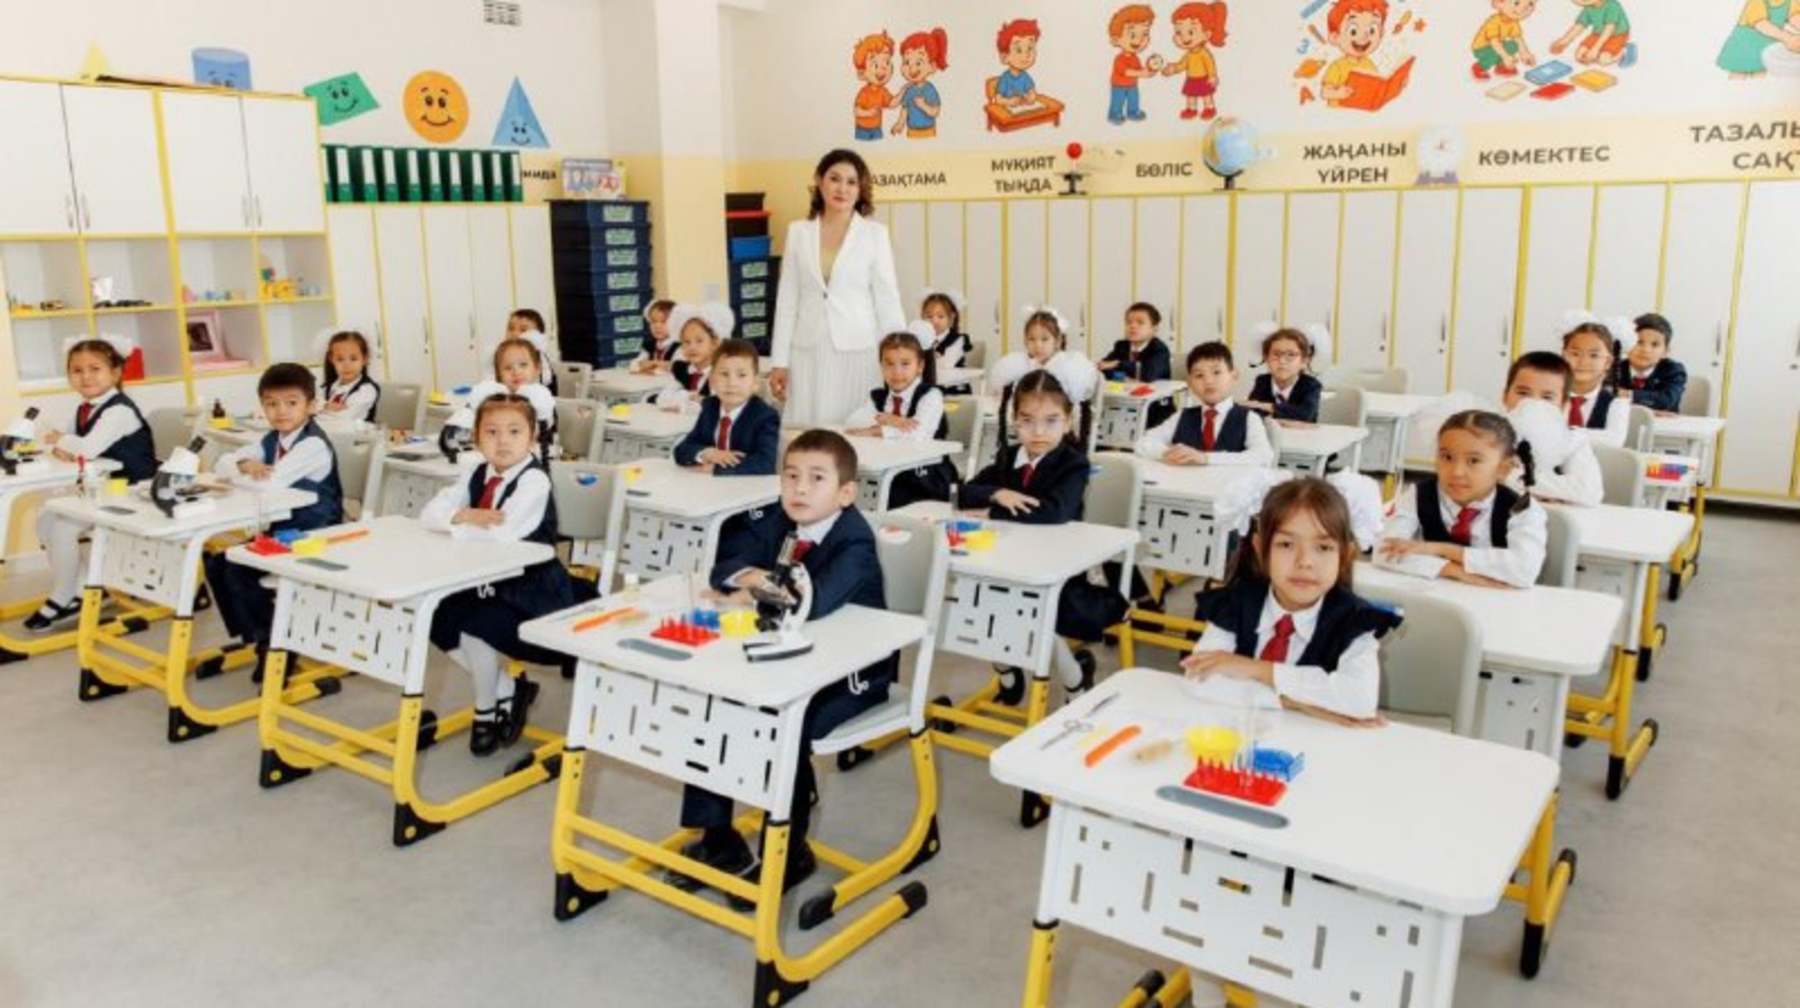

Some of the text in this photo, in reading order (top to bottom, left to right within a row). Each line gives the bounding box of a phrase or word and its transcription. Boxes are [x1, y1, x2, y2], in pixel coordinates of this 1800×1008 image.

[1303, 141, 1406, 160] ЖАҢАНЫ
[1478, 146, 1611, 166] КӨМЕКТЕС
[1318, 165, 1388, 184] ҮЙРЕН
[995, 178, 1052, 193] ТЫҢДА
